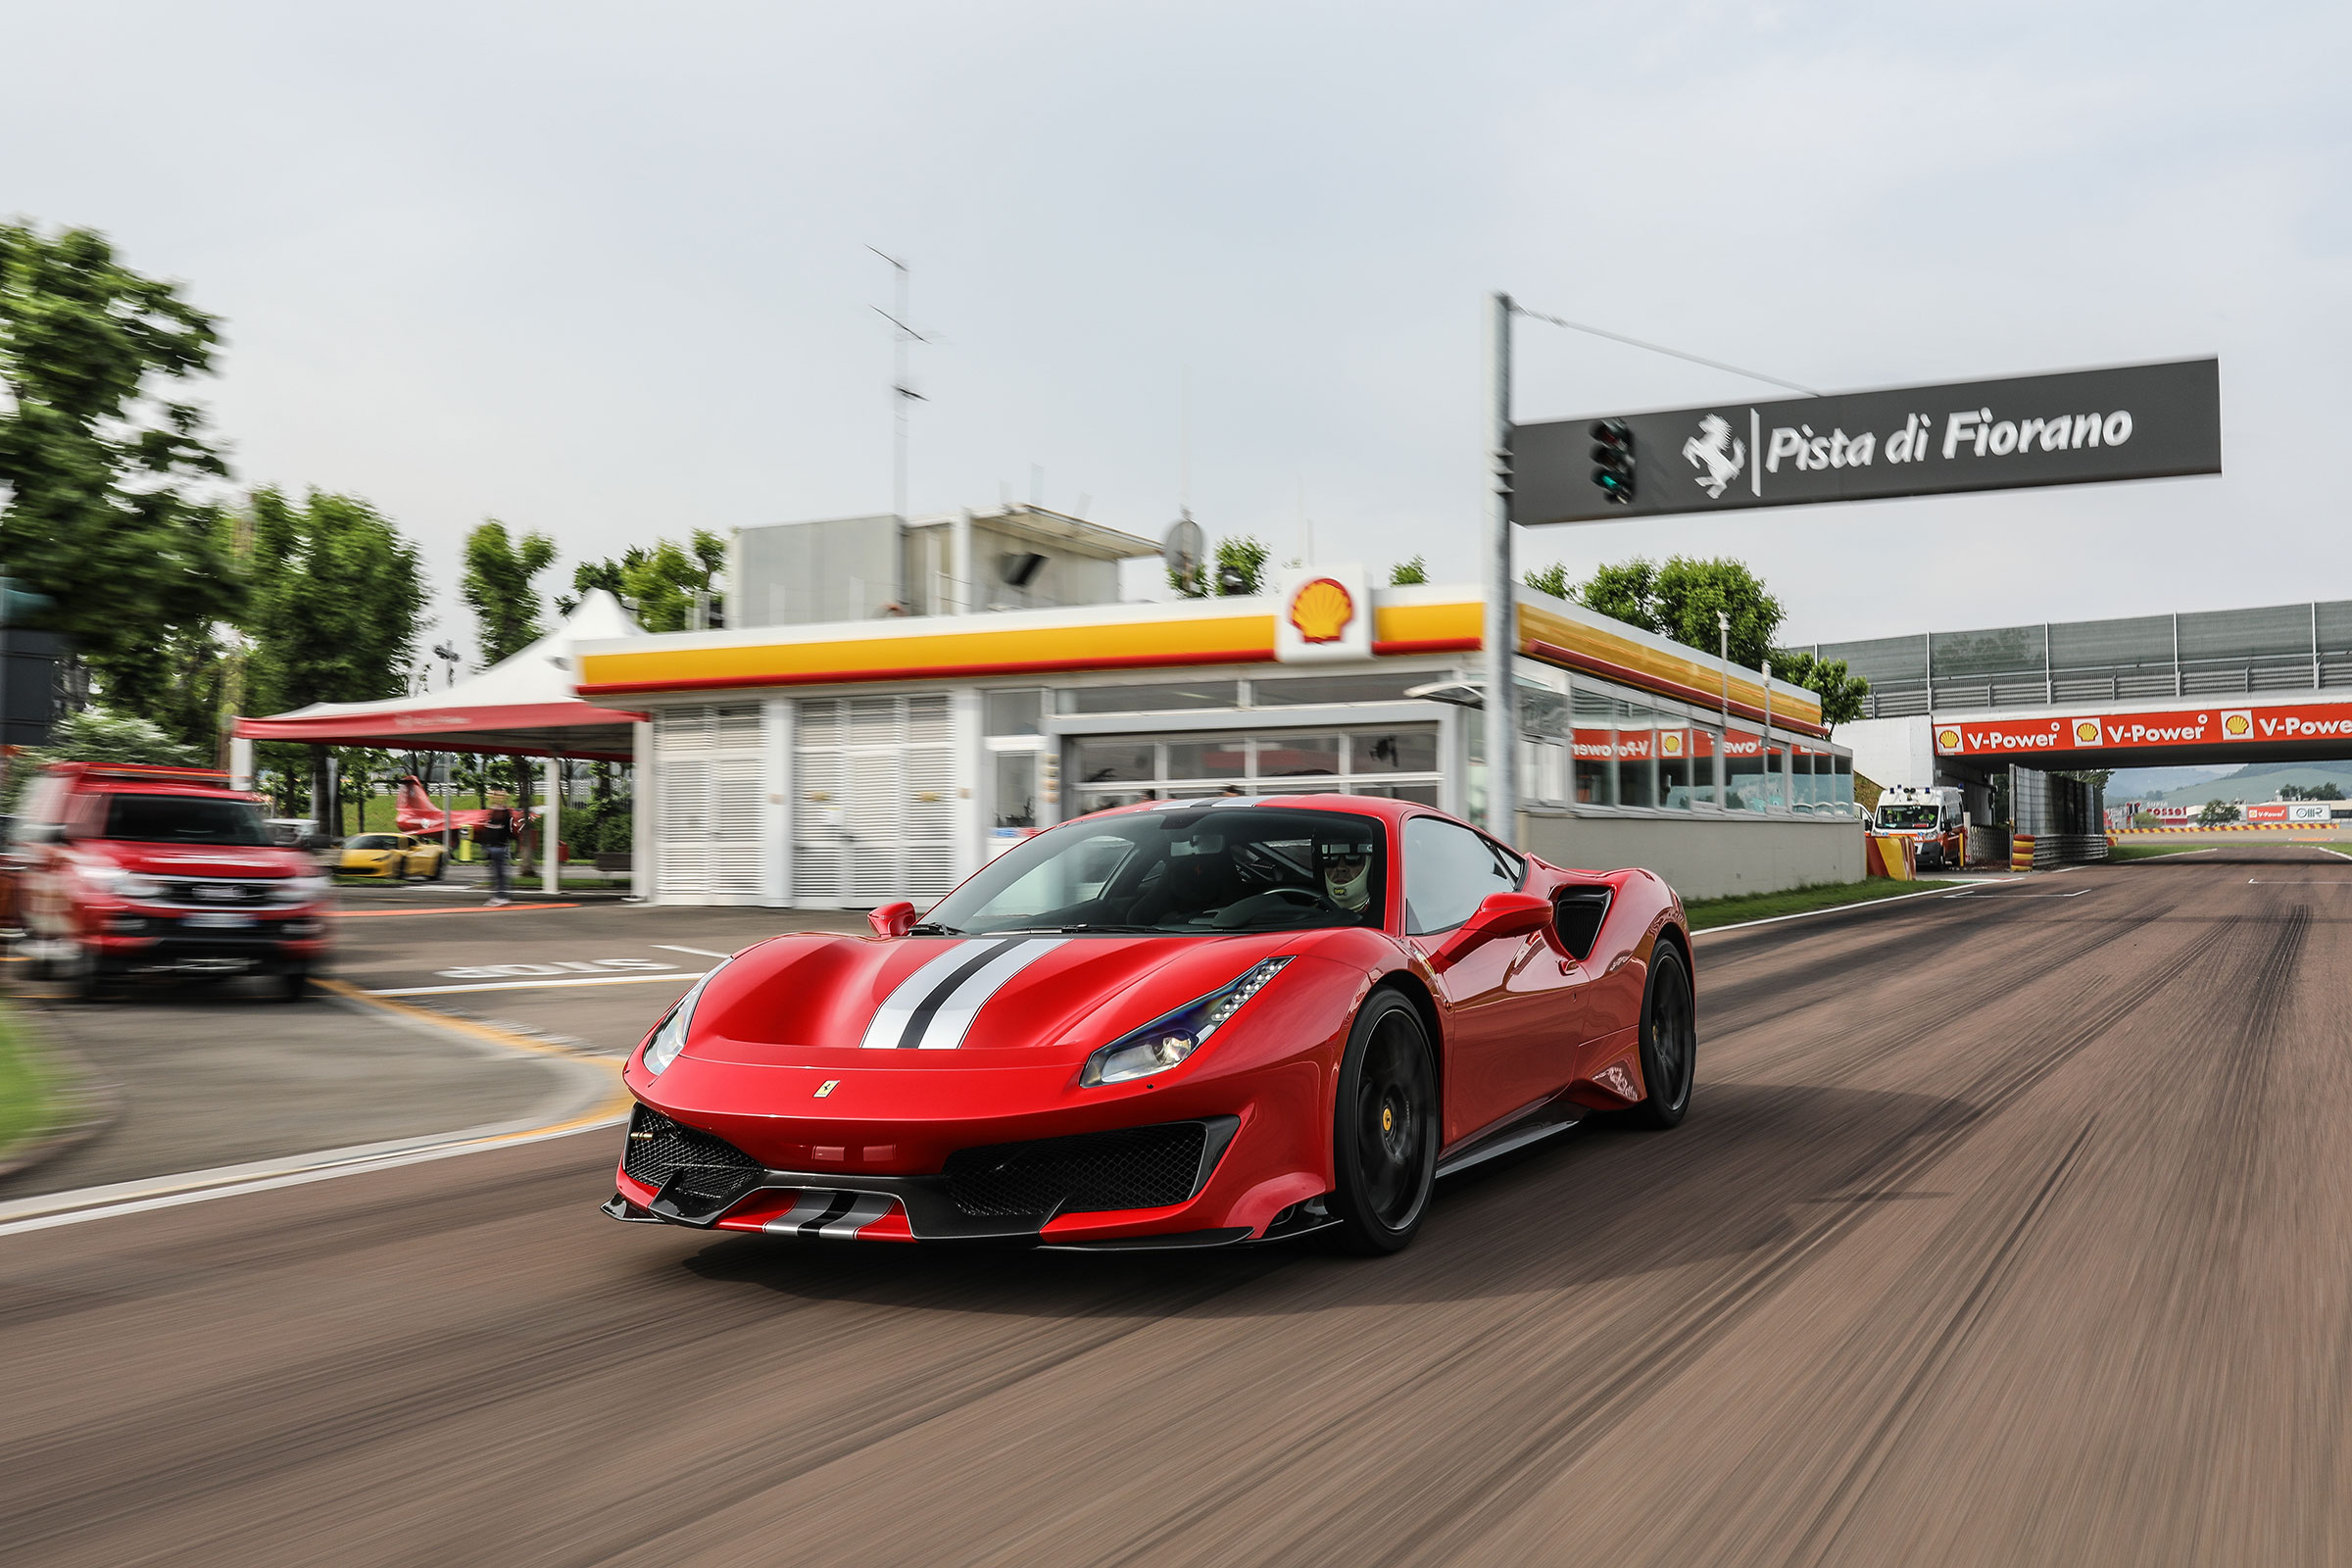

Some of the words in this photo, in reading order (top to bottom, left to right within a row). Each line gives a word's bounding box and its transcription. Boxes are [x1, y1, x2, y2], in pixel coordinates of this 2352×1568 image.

[1765, 423, 1876, 472] Pista
[1885, 413, 1932, 465] di
[1942, 407, 2133, 460] Fiorano
[2107, 724, 2205, 743] V-Power
[2259, 717, 2352, 736] V-Powe
[1967, 732, 2058, 750] V-Power
